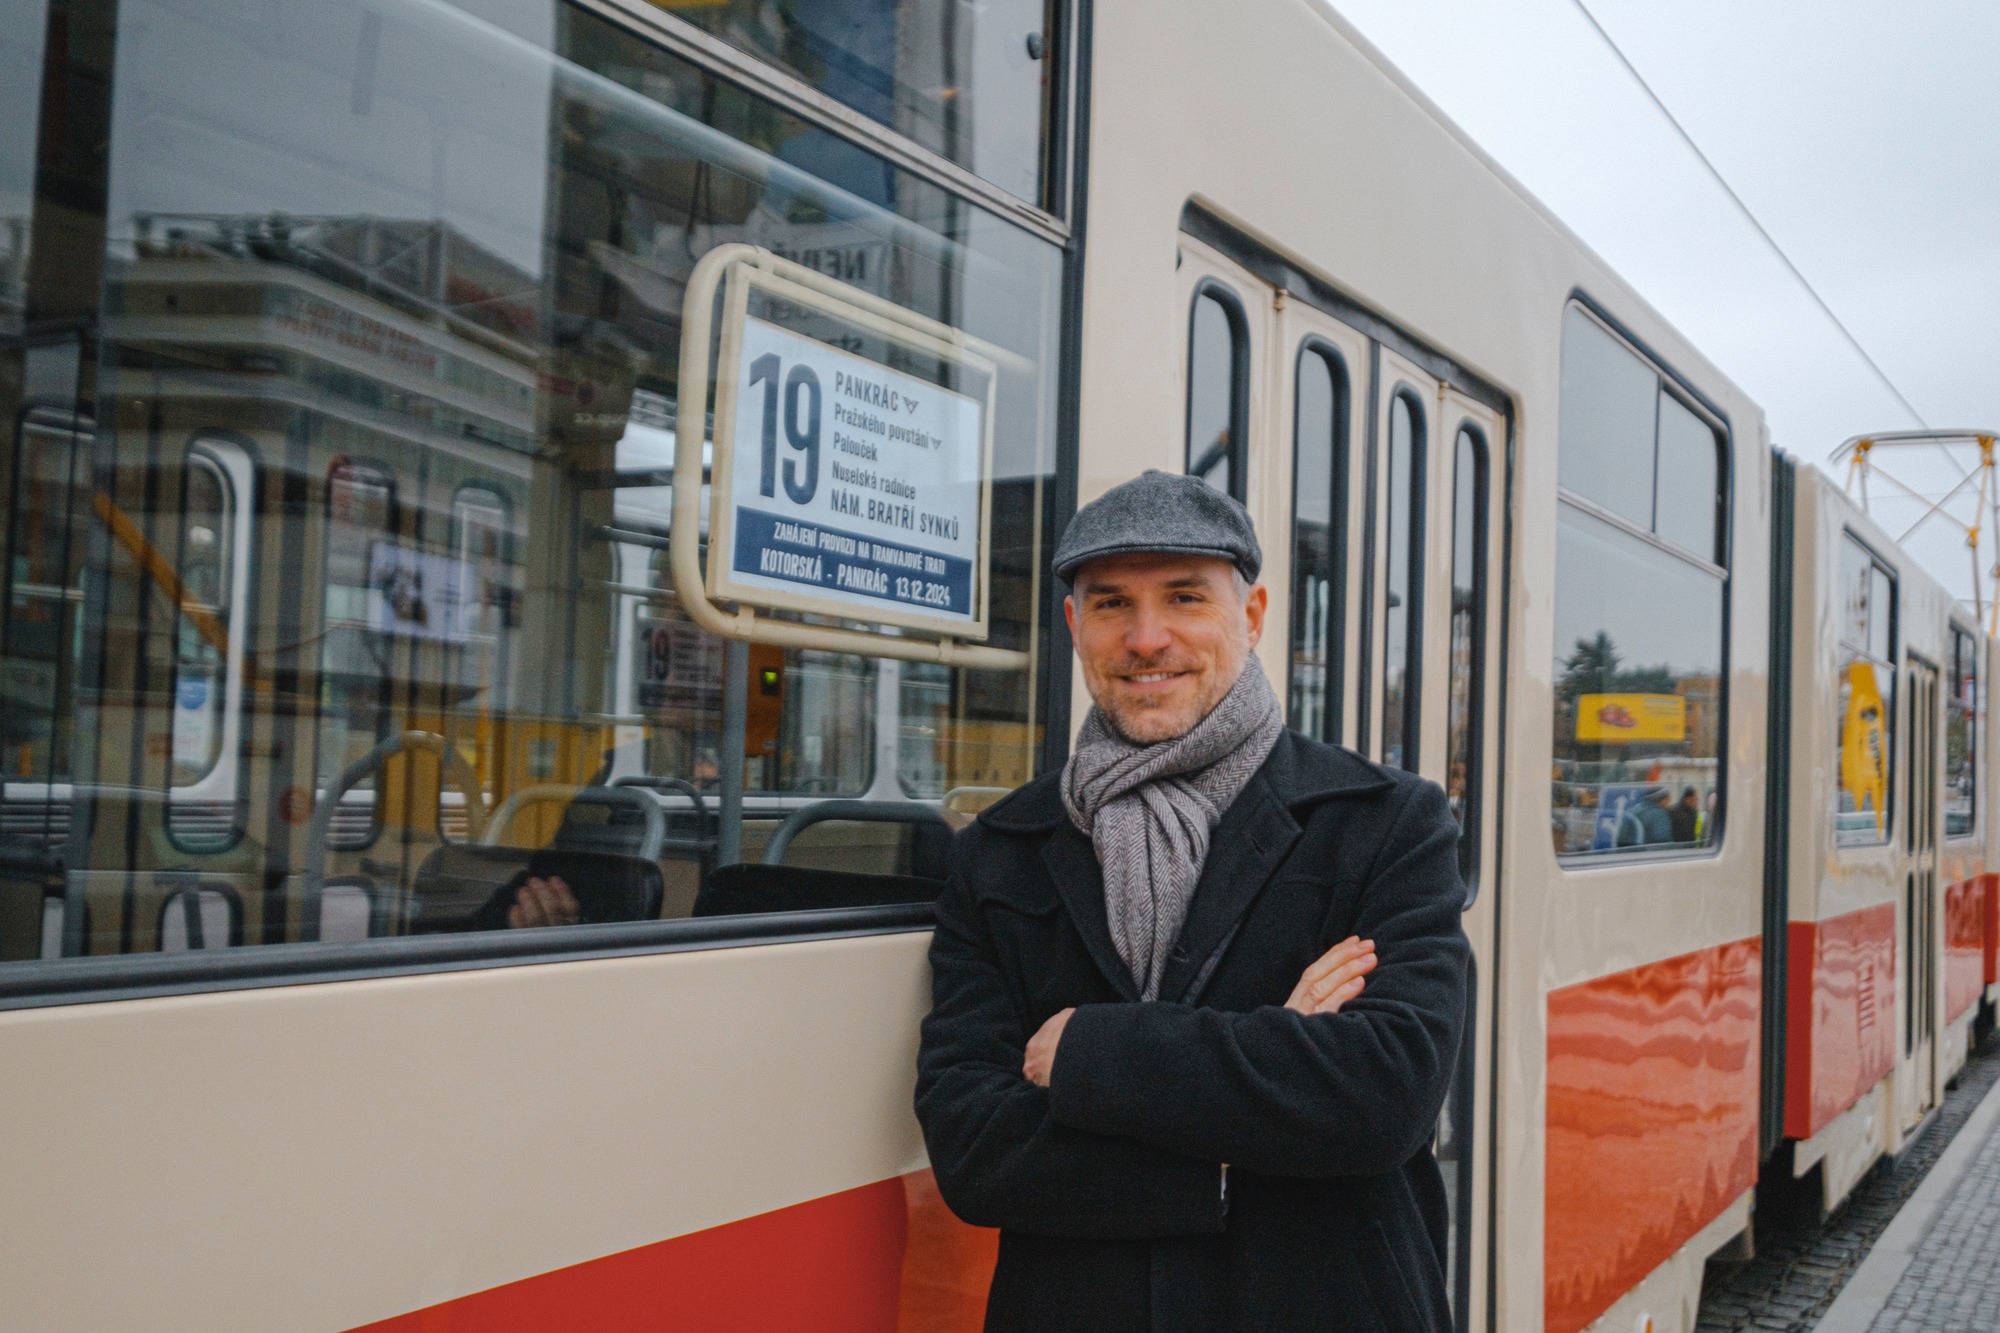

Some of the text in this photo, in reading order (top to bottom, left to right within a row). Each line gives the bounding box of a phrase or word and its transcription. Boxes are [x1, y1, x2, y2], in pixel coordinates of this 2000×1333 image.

[835, 370, 899, 411] PANKRÁC
[749, 352, 822, 505] 19
[834, 402, 886, 436] Pražského
[833, 431, 878, 461] Palouček
[832, 460, 916, 500] Nuselská radnice
[831, 488, 959, 541] NÁM. BRATŘÍ SYNKŮ
[773, 521, 946, 575] ZAHÁJENÍ PROVOZU NA TRAMVAJOVÉ TRATI
[760, 547, 822, 581] KOTORSKÁ
[836, 563, 888, 594] PANKRÁC
[896, 576, 951, 606] 13.12.2024
